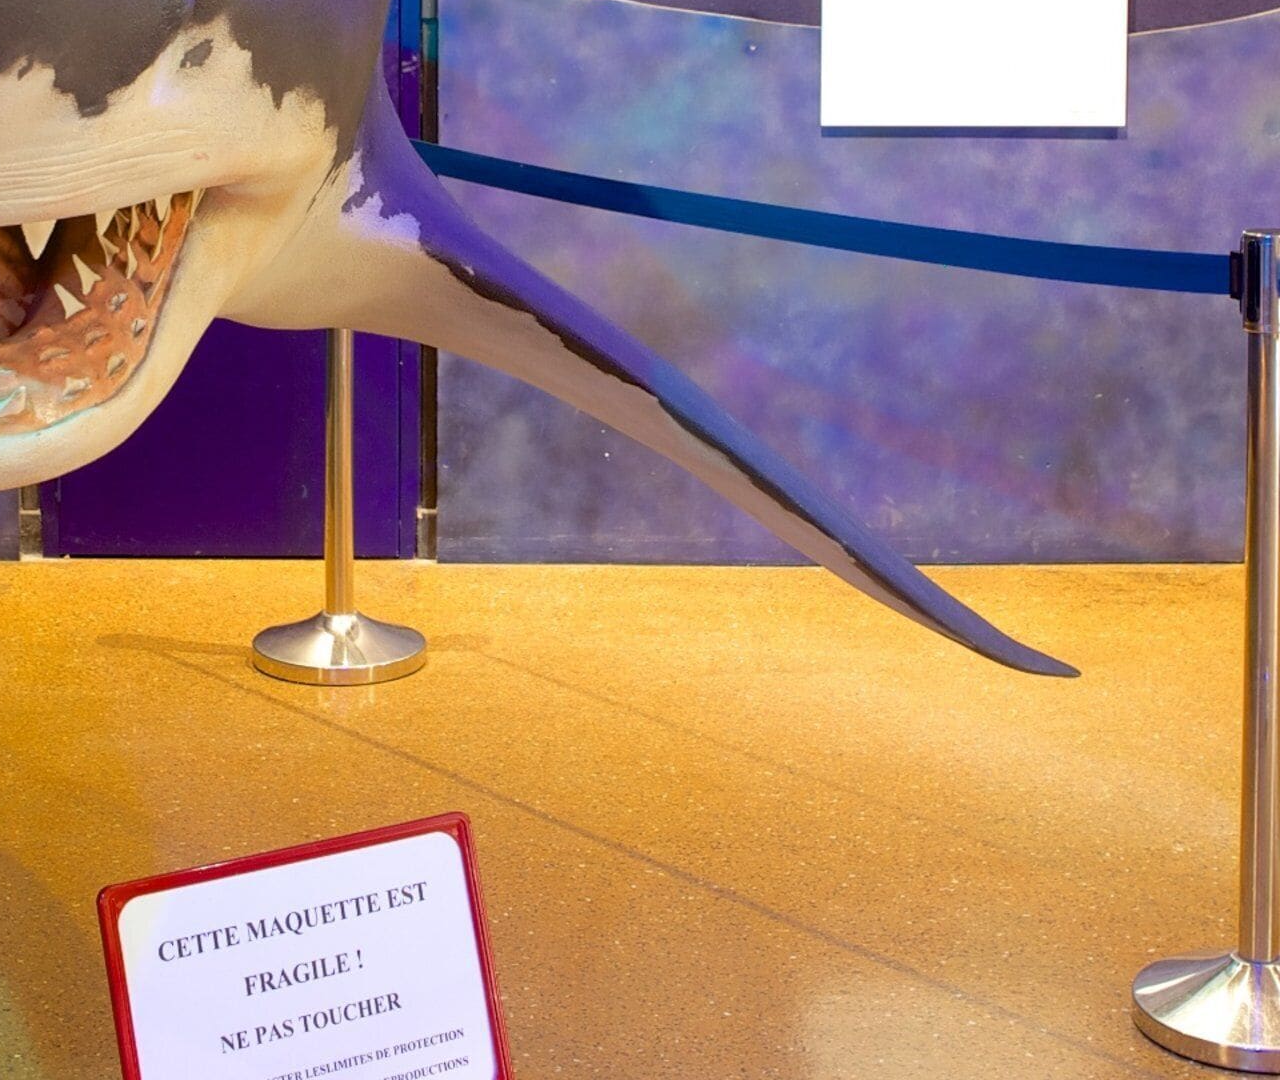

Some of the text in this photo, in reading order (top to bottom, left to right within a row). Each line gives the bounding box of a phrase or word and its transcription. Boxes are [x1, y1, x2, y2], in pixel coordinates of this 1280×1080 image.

[158, 882, 428, 962] CETTE MAQUETTE EST
[244, 949, 363, 996] FRAGILE !
[220, 992, 402, 1053] NE PAS TOUCHER
[376, 1047, 391, 1060] DE
[393, 1027, 464, 1055] PROTECTION
[384, 1056, 469, 1080] PRODUCTIONS
